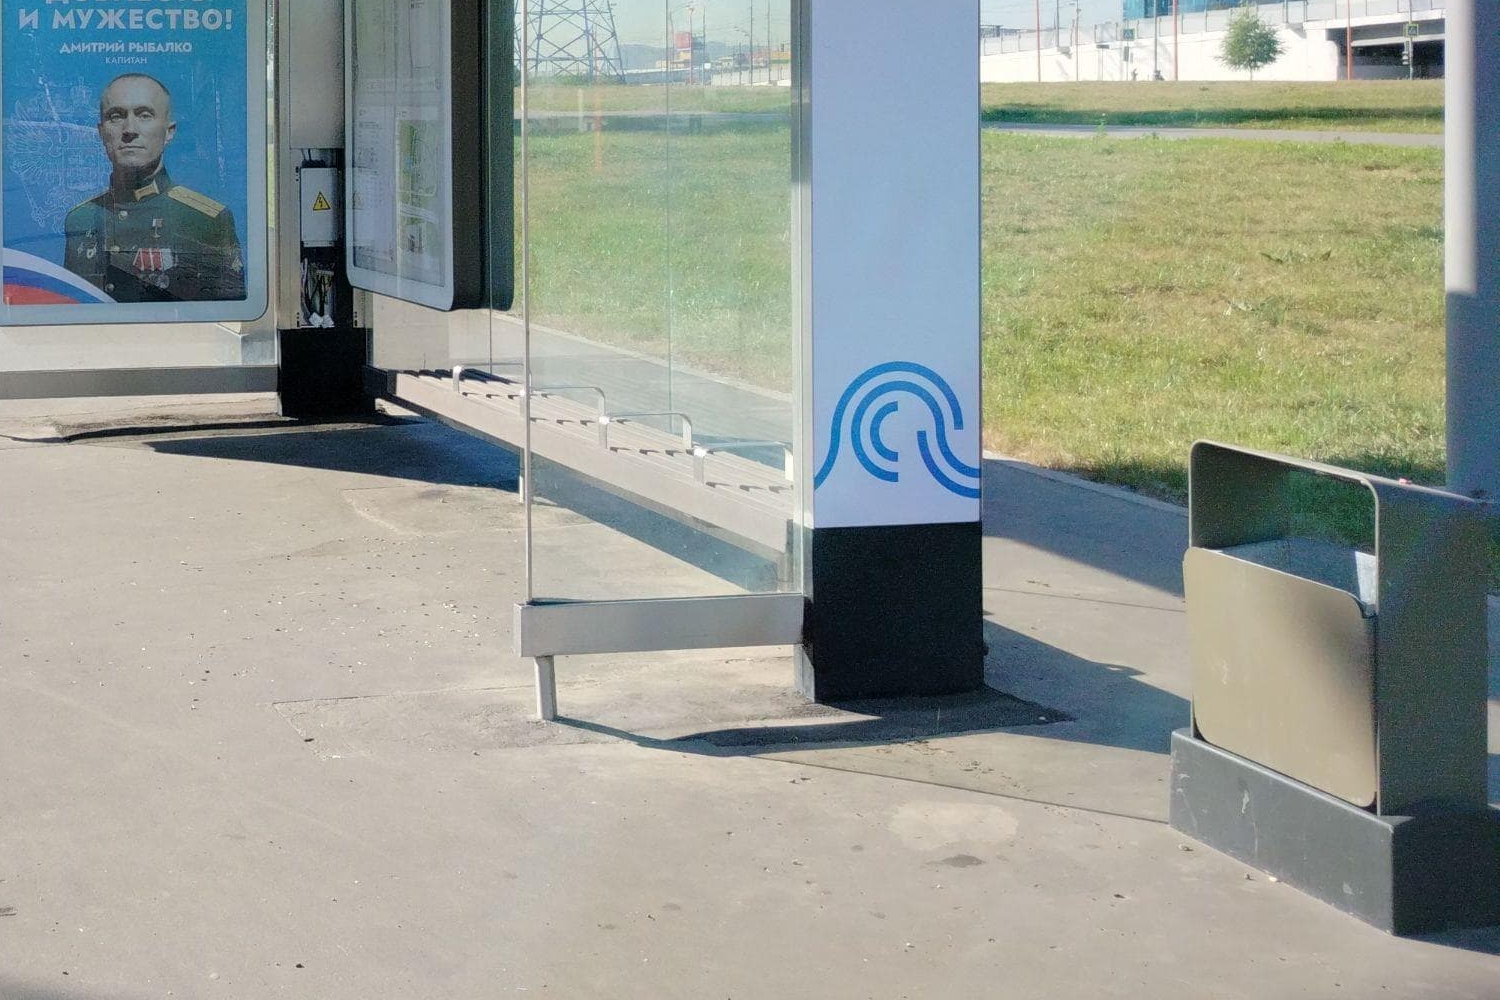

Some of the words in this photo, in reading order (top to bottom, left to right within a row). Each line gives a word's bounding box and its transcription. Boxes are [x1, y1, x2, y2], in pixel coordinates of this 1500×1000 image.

[18, 8, 39, 30] И
[52, 8, 233, 30] МУЖЕСТВО!
[59, 40, 125, 55] ДМИТРИЙ
[128, 42, 193, 53] РЫБАЛКО
[105, 56, 148, 65] КАПИТАН
